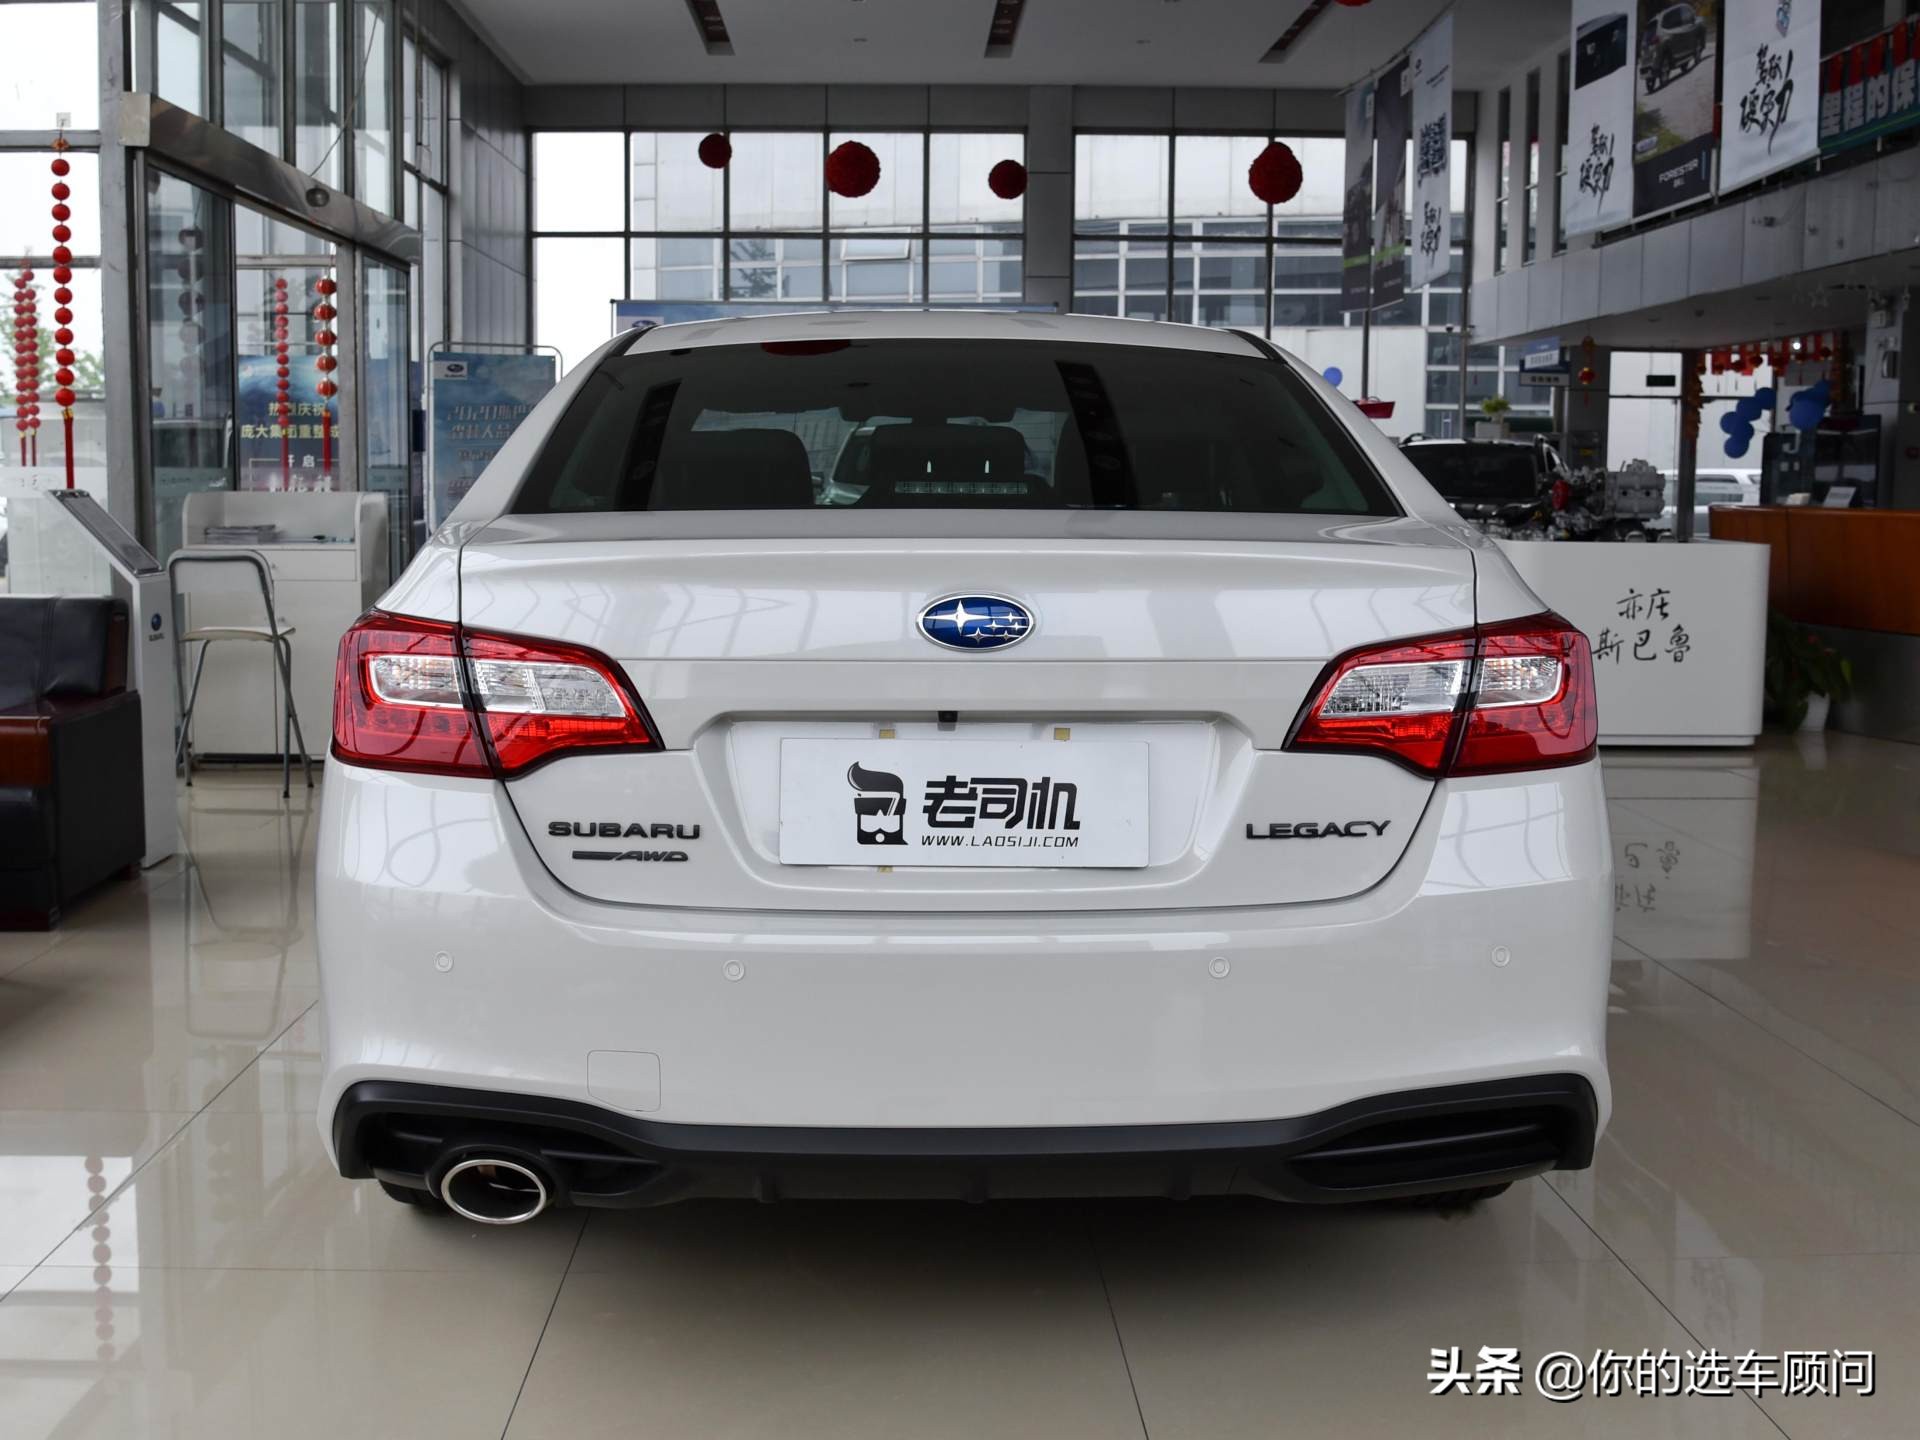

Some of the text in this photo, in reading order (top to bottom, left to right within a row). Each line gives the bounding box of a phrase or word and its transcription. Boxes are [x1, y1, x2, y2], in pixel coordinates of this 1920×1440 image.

[1616, 588, 1670, 620] 亦庄
[1592, 624, 1690, 664] 斯巴鲁
[922, 775, 1080, 830] 老司机
[548, 821, 700, 840] SUBARU
[1246, 820, 1391, 839] LEGACY
[921, 835, 1079, 848] WWW.LAOSIJI.COM
[614, 851, 688, 862] AWD
